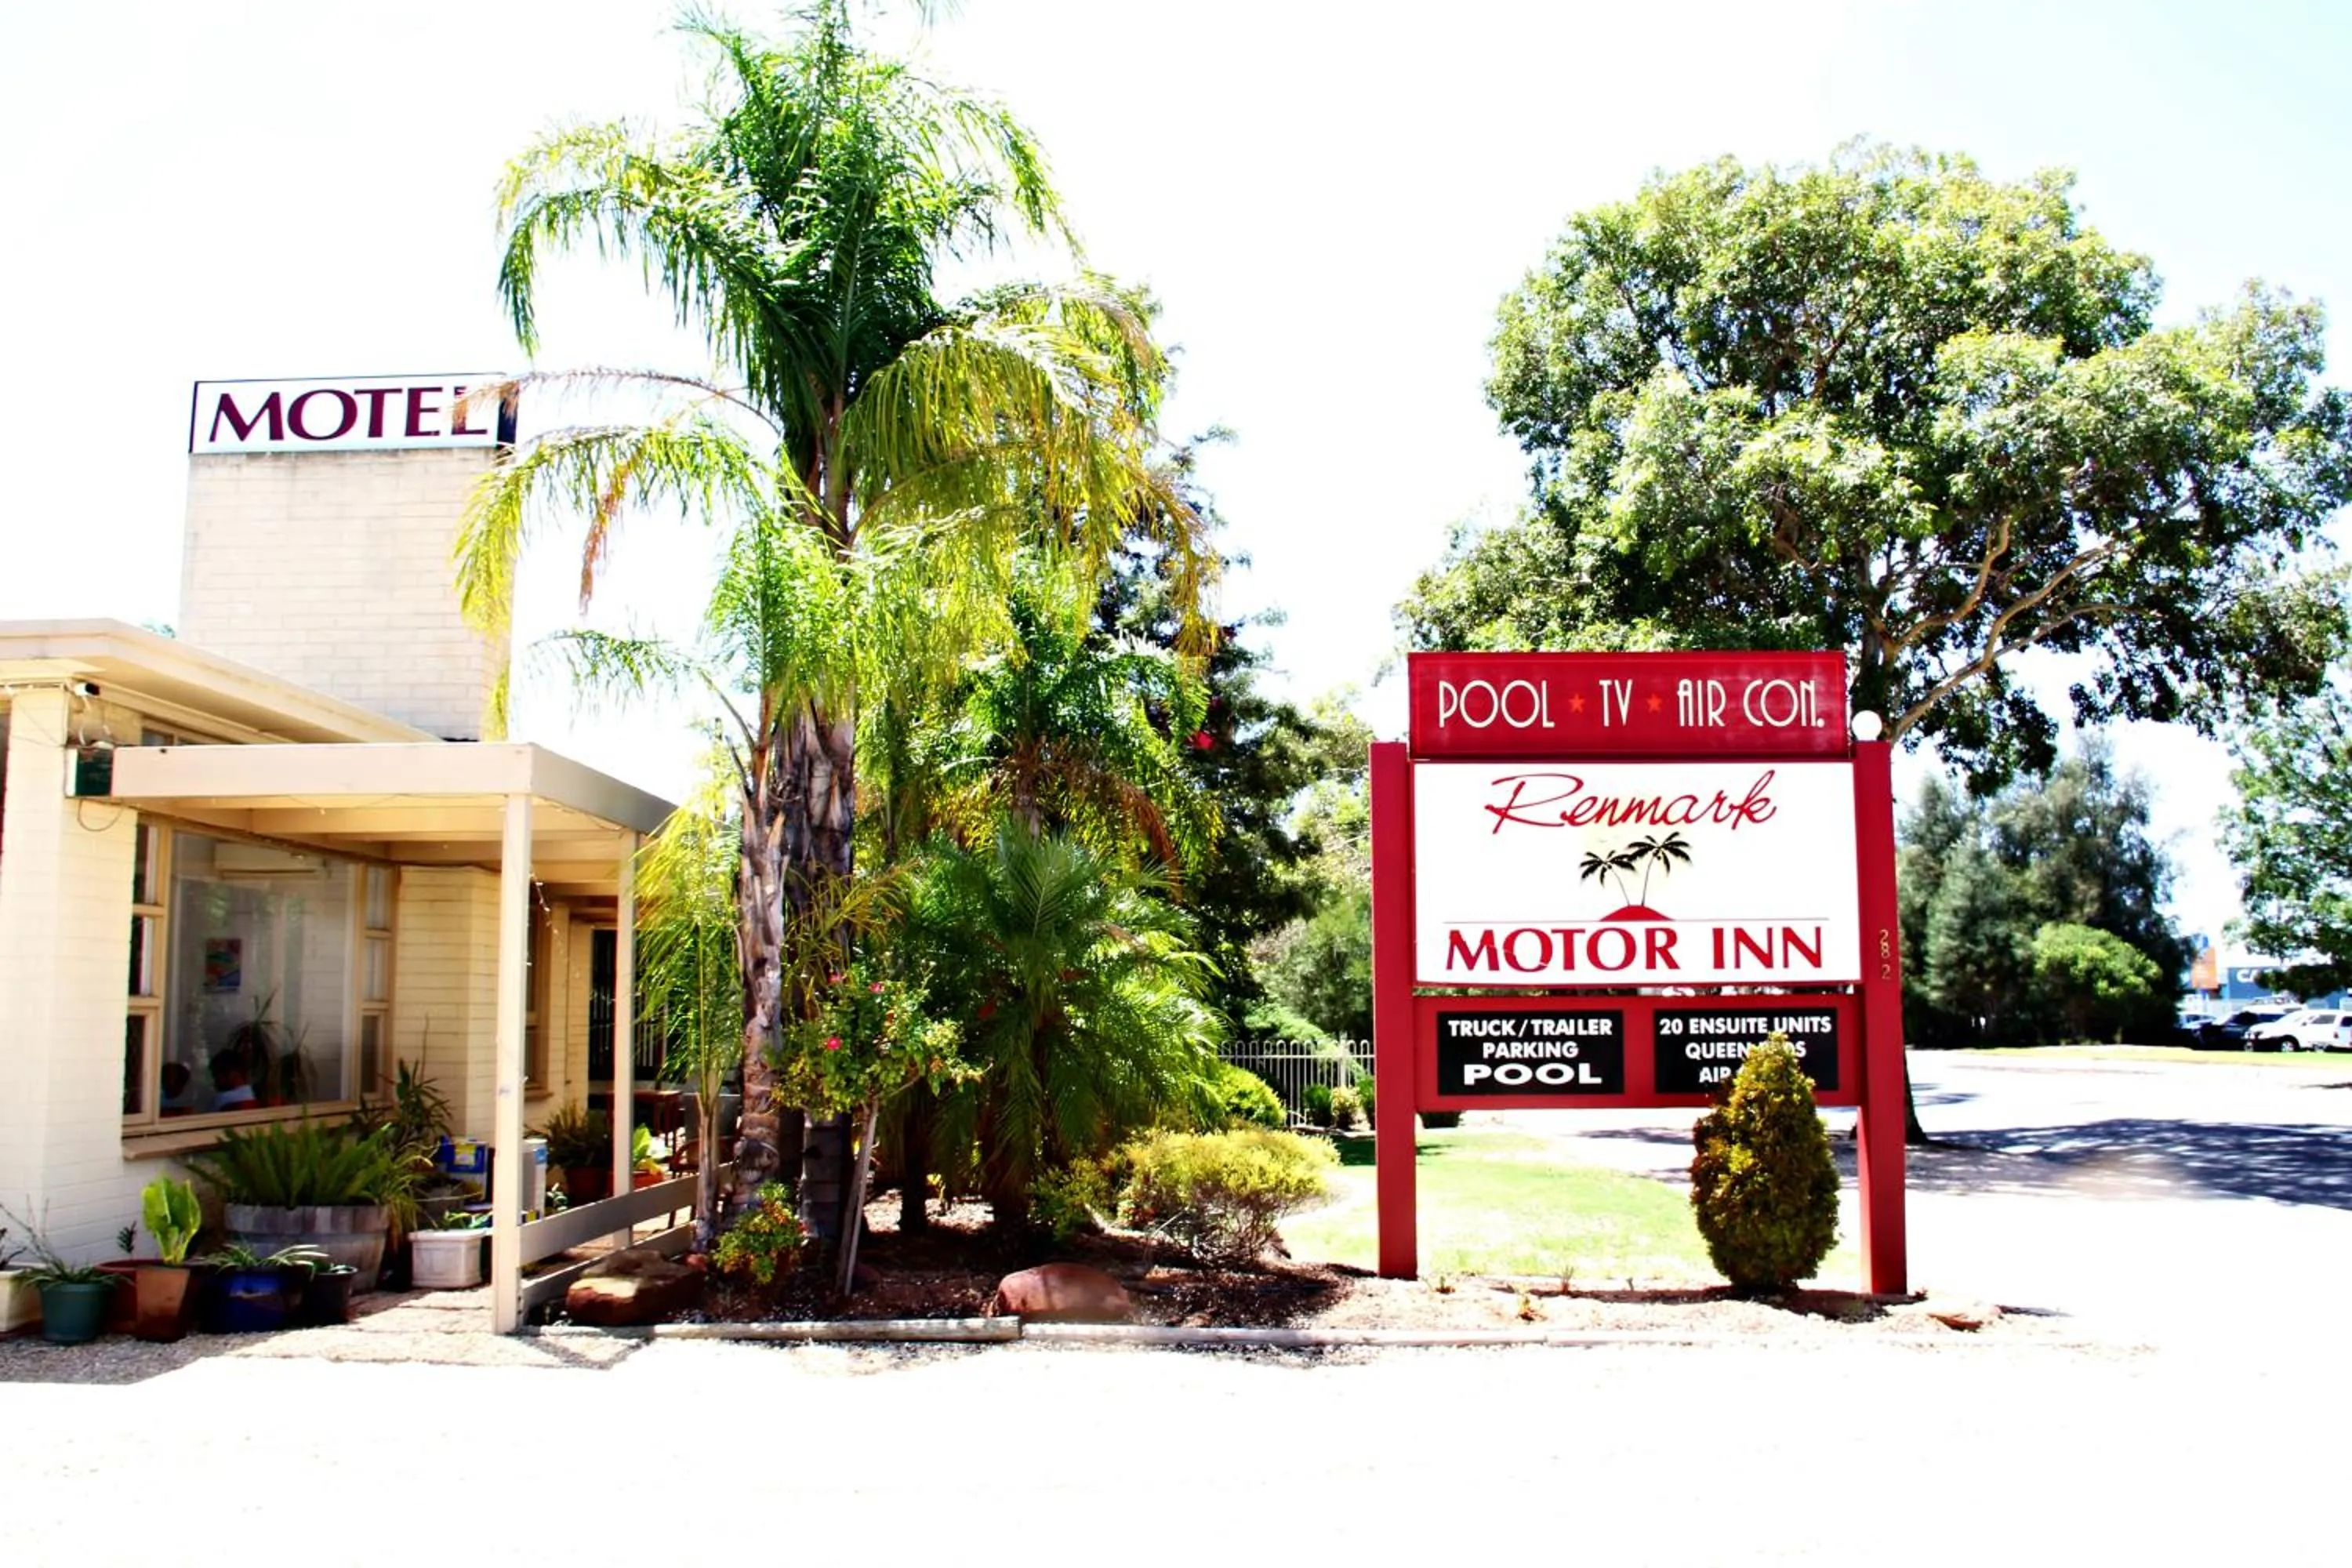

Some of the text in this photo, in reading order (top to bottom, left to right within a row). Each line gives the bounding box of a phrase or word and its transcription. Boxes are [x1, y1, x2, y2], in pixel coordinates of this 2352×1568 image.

[209, 387, 488, 442] MOTEL
[1439, 678, 1826, 728] POOL TV AIR CON.
[1484, 769, 1777, 834] Renmark
[1446, 926, 1823, 972] MOTOR INN
[1659, 1016, 1832, 1035] 20 ENSUITE UNITS
[1483, 1041, 1579, 1058] PARKING
[1686, 1042, 1751, 1060] QUEEN
[1464, 1062, 1602, 1086] POOL
